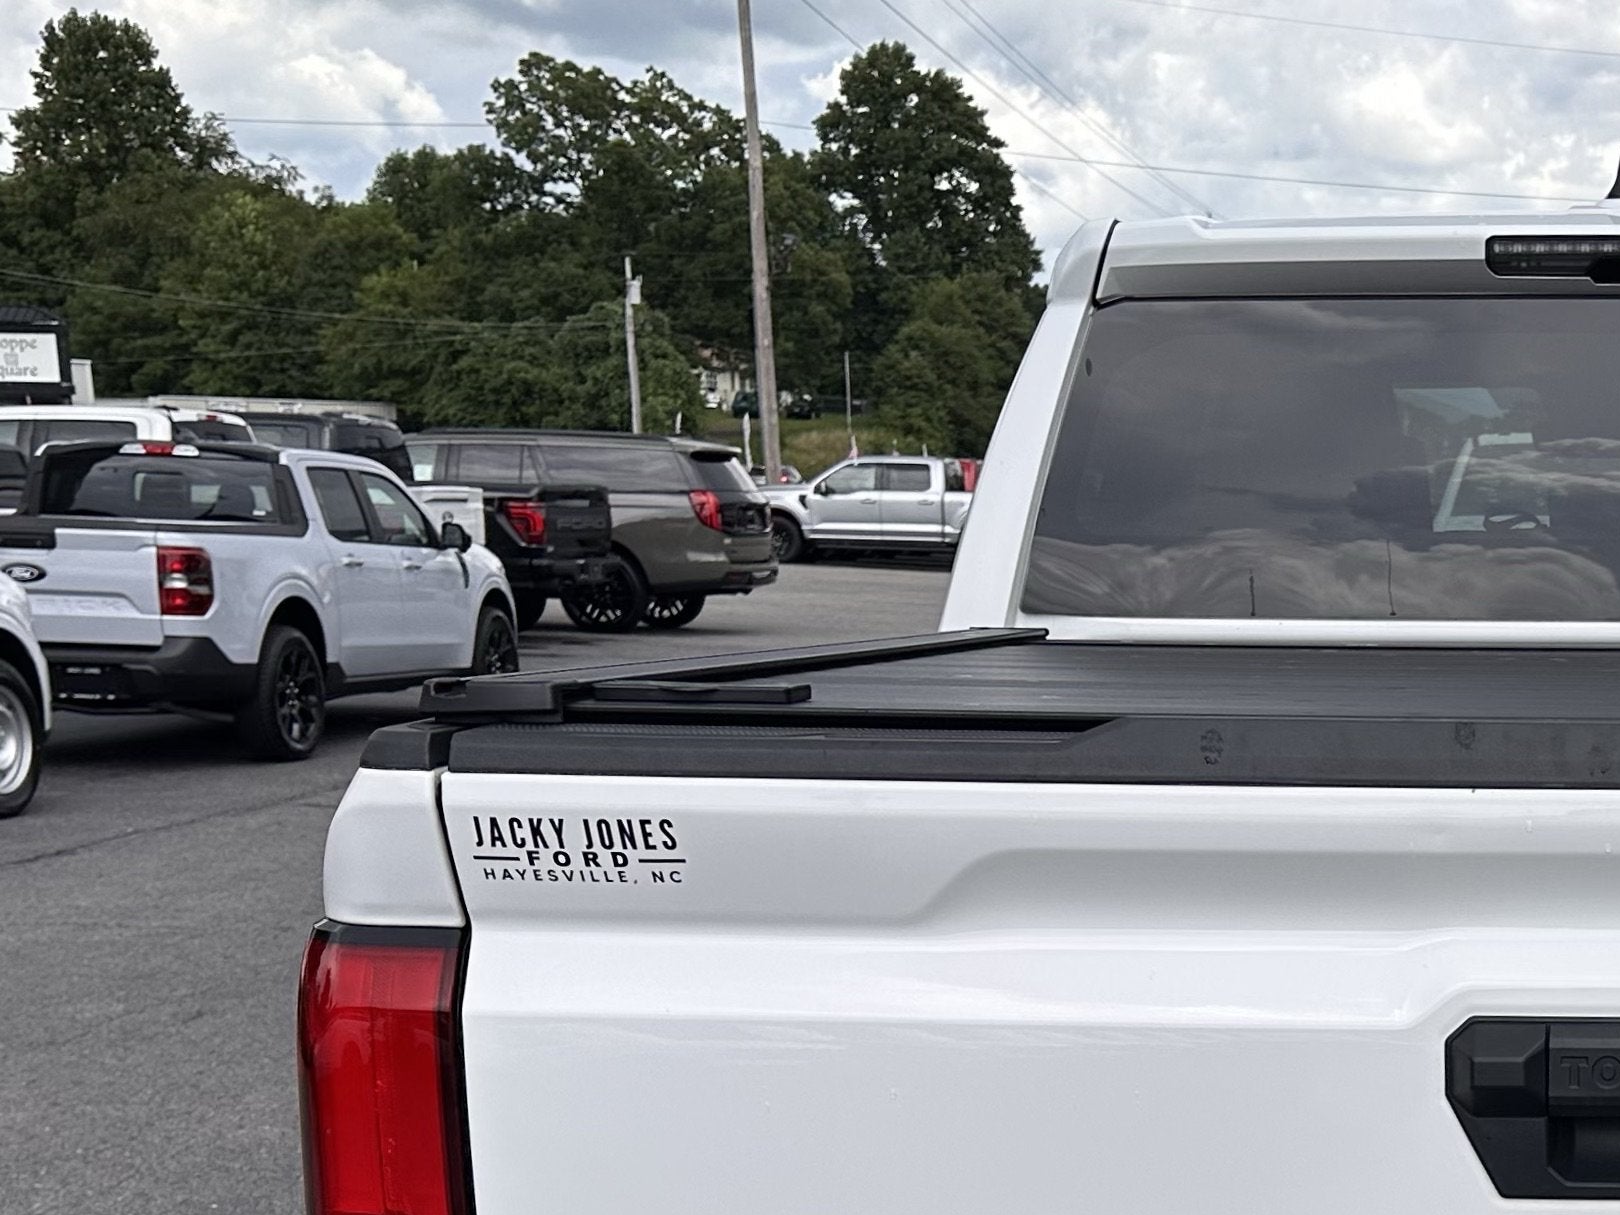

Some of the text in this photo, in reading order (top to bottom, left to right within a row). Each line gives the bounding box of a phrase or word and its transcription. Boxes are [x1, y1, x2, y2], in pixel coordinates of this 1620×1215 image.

[472, 815, 678, 851] JACKY JONES
[525, 850, 630, 868] FORD
[483, 867, 684, 885] HAYESVILLE, NC
